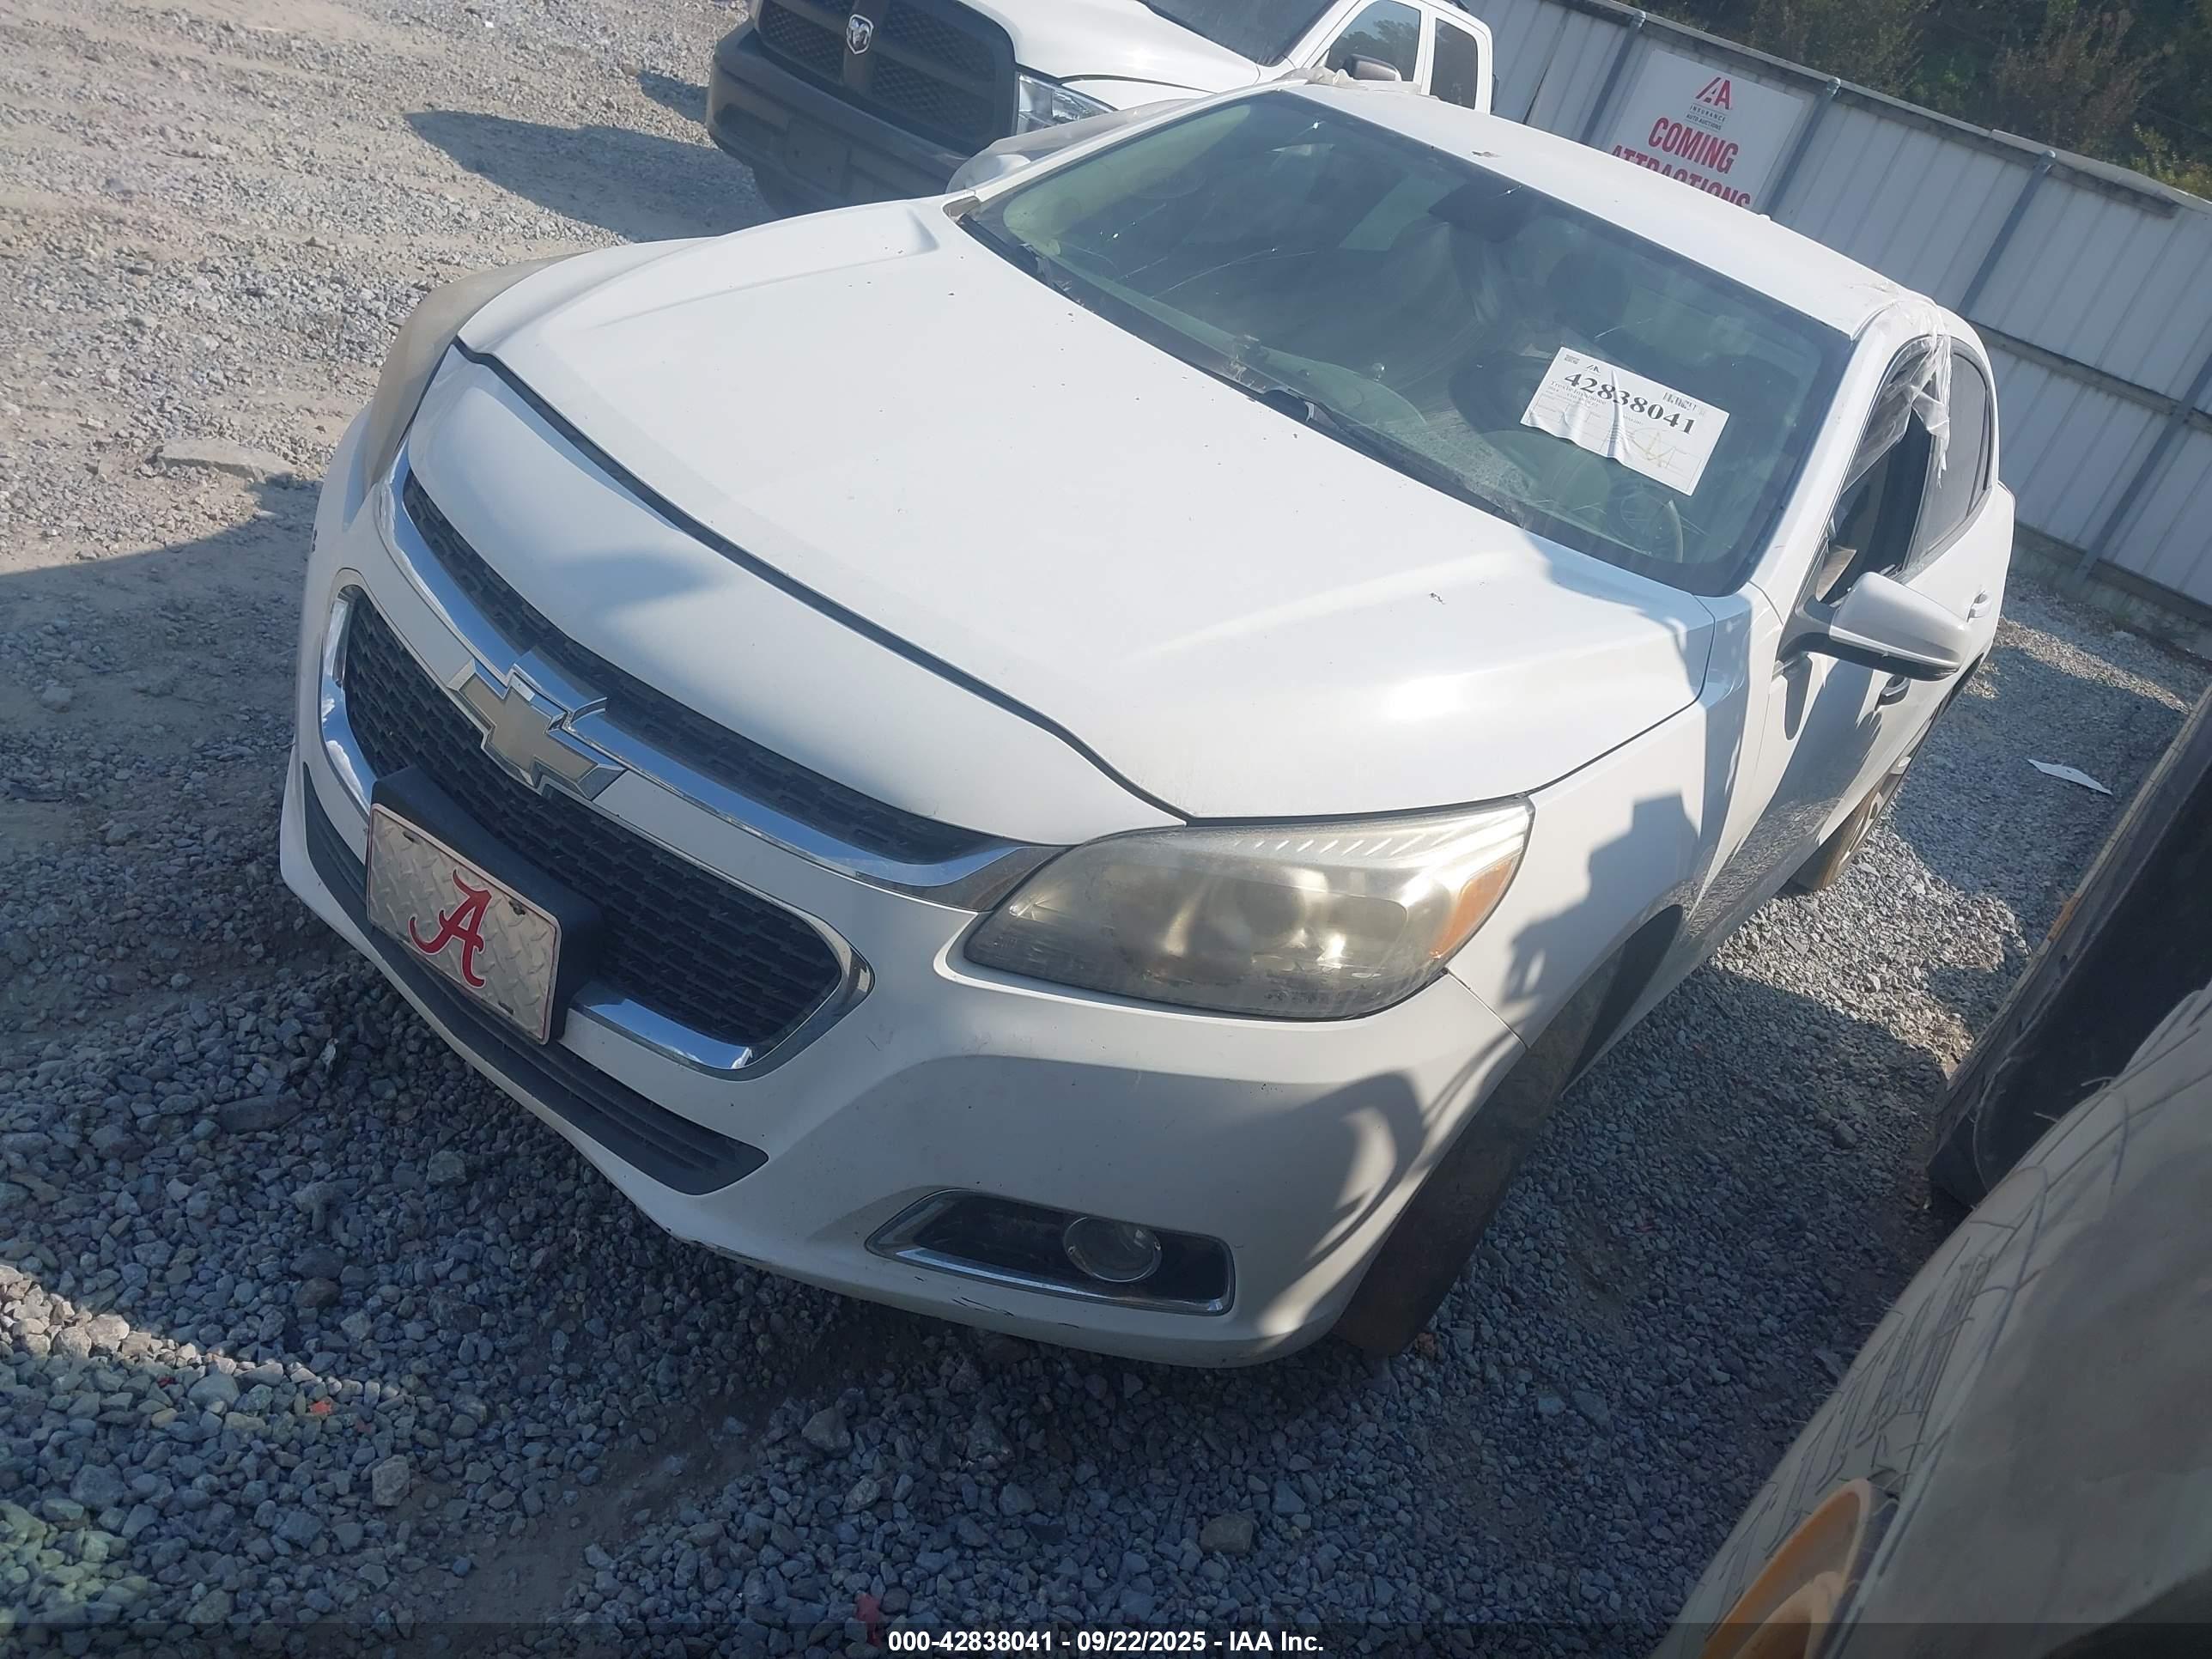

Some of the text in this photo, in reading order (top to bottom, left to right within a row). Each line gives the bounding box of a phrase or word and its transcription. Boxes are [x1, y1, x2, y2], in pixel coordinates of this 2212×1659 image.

[1686, 113, 1722, 131] AUTO AUCTIONS
[1689, 105, 1726, 122] INSURANCE
[1648, 117, 1739, 174] COMING
[1564, 373, 1697, 435] 42838041
[409, 868, 492, 988] A
